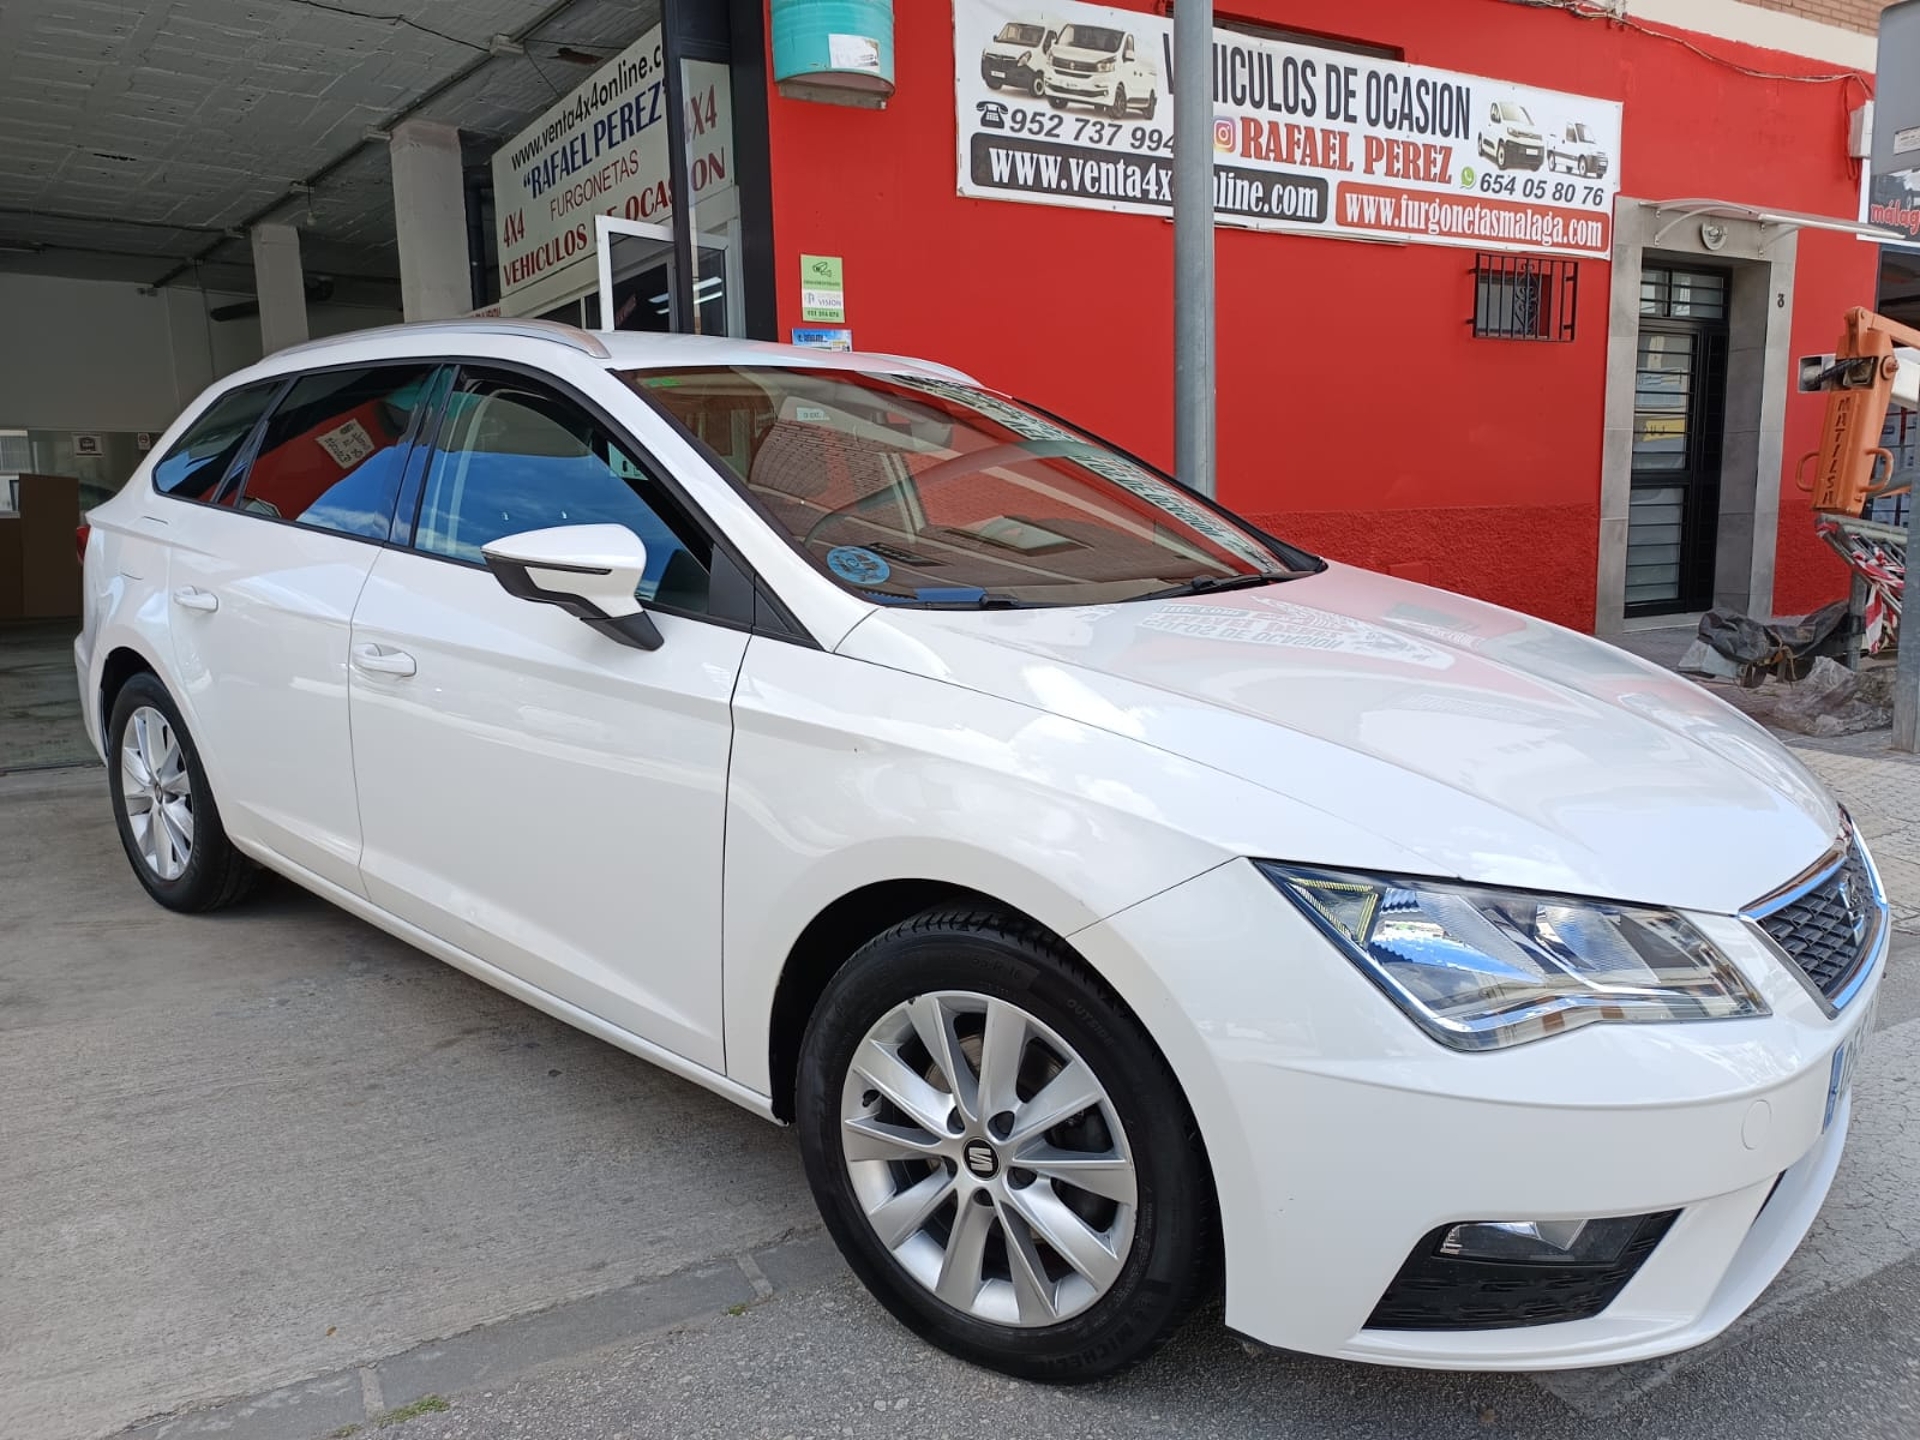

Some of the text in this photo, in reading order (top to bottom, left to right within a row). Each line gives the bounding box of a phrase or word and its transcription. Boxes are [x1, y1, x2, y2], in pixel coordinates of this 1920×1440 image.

[1009, 108, 1063, 138] 952
[1073, 118, 1122, 147] 737
[1326, 64, 1357, 123] DE
[1366, 69, 1471, 140] OCASION
[1240, 116, 1453, 185] RAFAEL PEREZ
[503, 207, 525, 248] 4X4
[550, 150, 640, 221] FURGONETAS
[1345, 192, 1602, 247] www.furgonetasmalaga.com
[1480, 172, 1604, 206] 654 05 80 76
[503, 223, 587, 286] VEHICULOS
